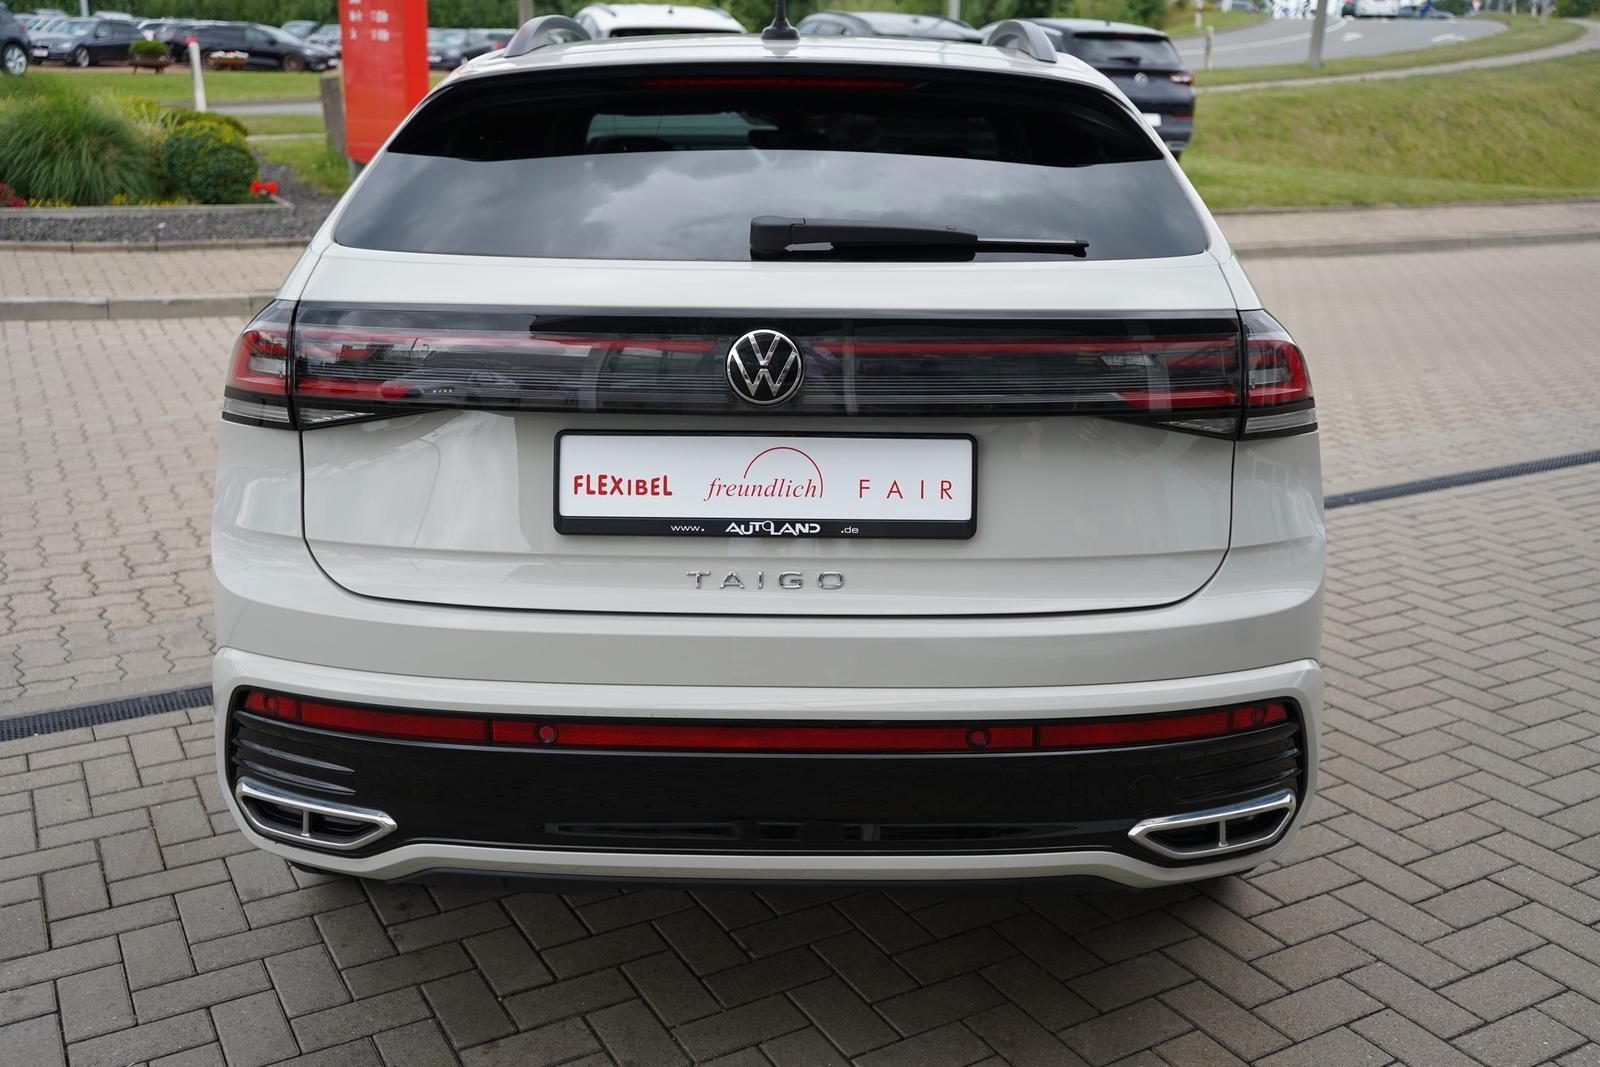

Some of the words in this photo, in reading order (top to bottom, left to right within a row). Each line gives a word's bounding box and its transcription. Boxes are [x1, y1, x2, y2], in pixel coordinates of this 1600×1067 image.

[727, 329, 803, 404] VW
[573, 474, 673, 497] FLEXIBEL
[703, 477, 817, 502] freundlich
[858, 479, 953, 500] FAIR
[725, 520, 821, 536] AUTOLAND
[840, 526, 859, 534] .de
[686, 569, 846, 590] TAIGO
